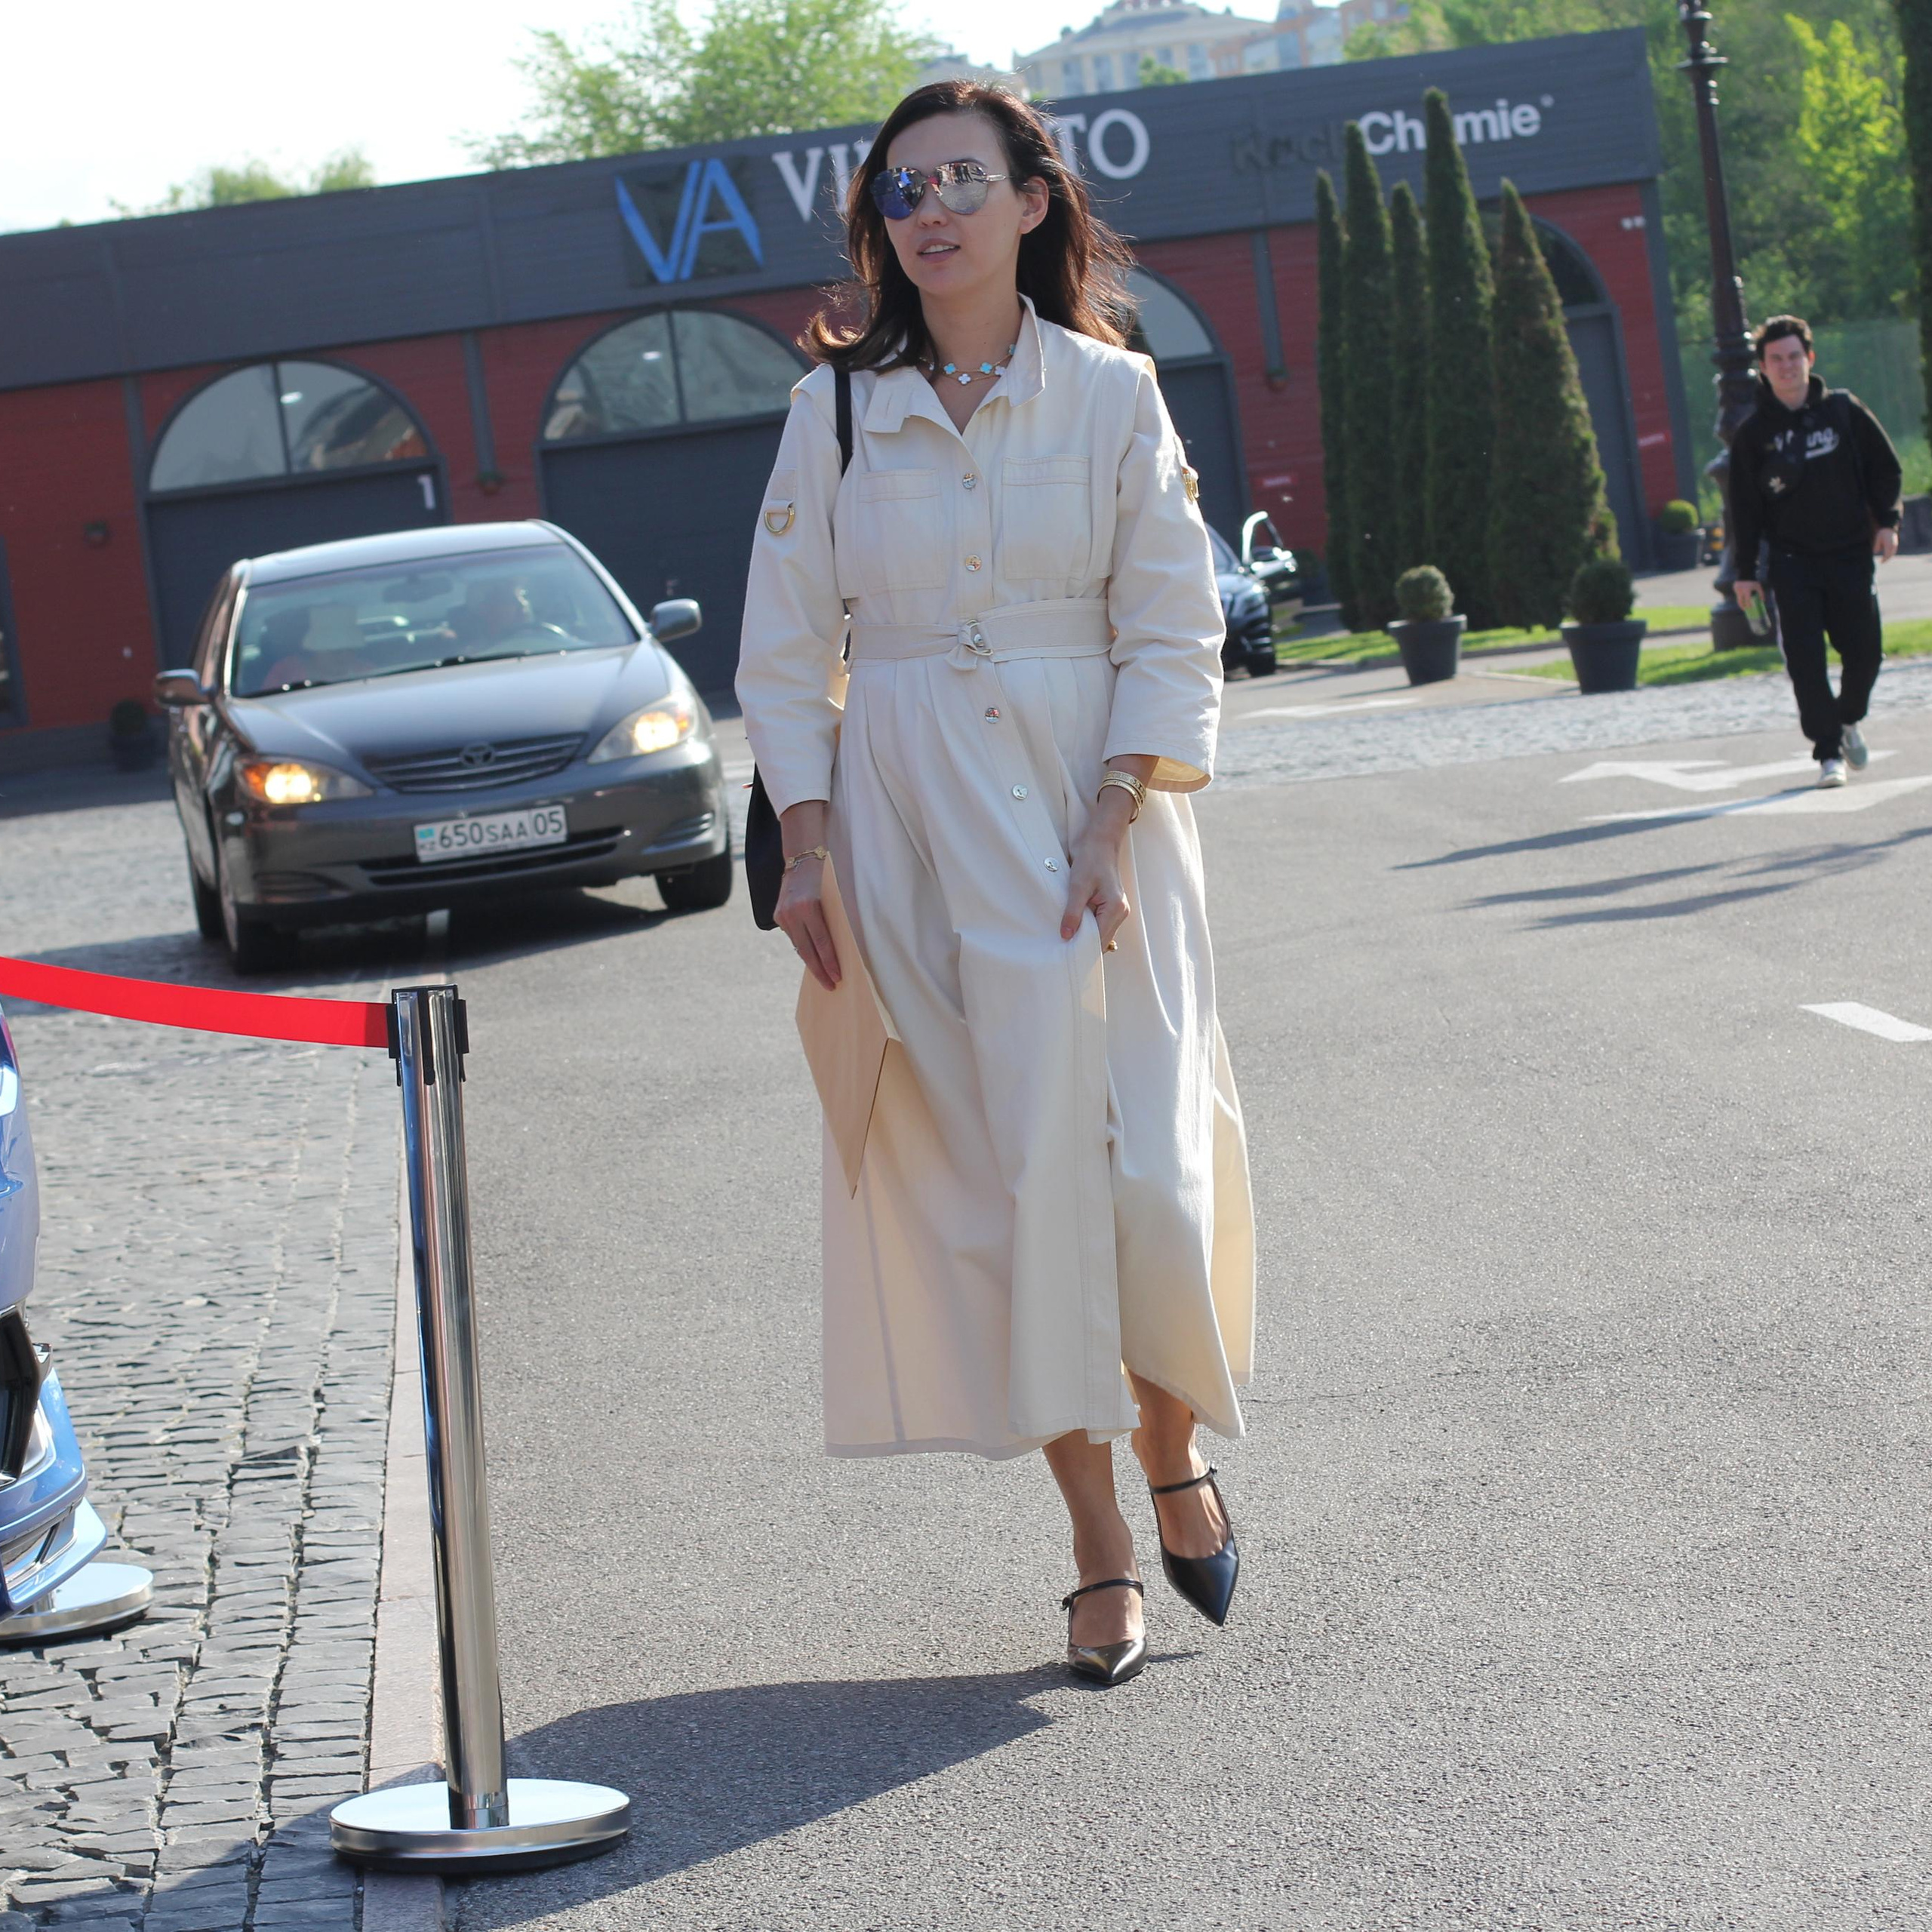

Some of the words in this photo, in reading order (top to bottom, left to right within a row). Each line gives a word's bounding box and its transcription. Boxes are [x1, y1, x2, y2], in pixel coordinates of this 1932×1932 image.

[1358, 98, 1541, 155] Chmie
[614, 158, 764, 284] VA
[417, 475, 436, 510] 1
